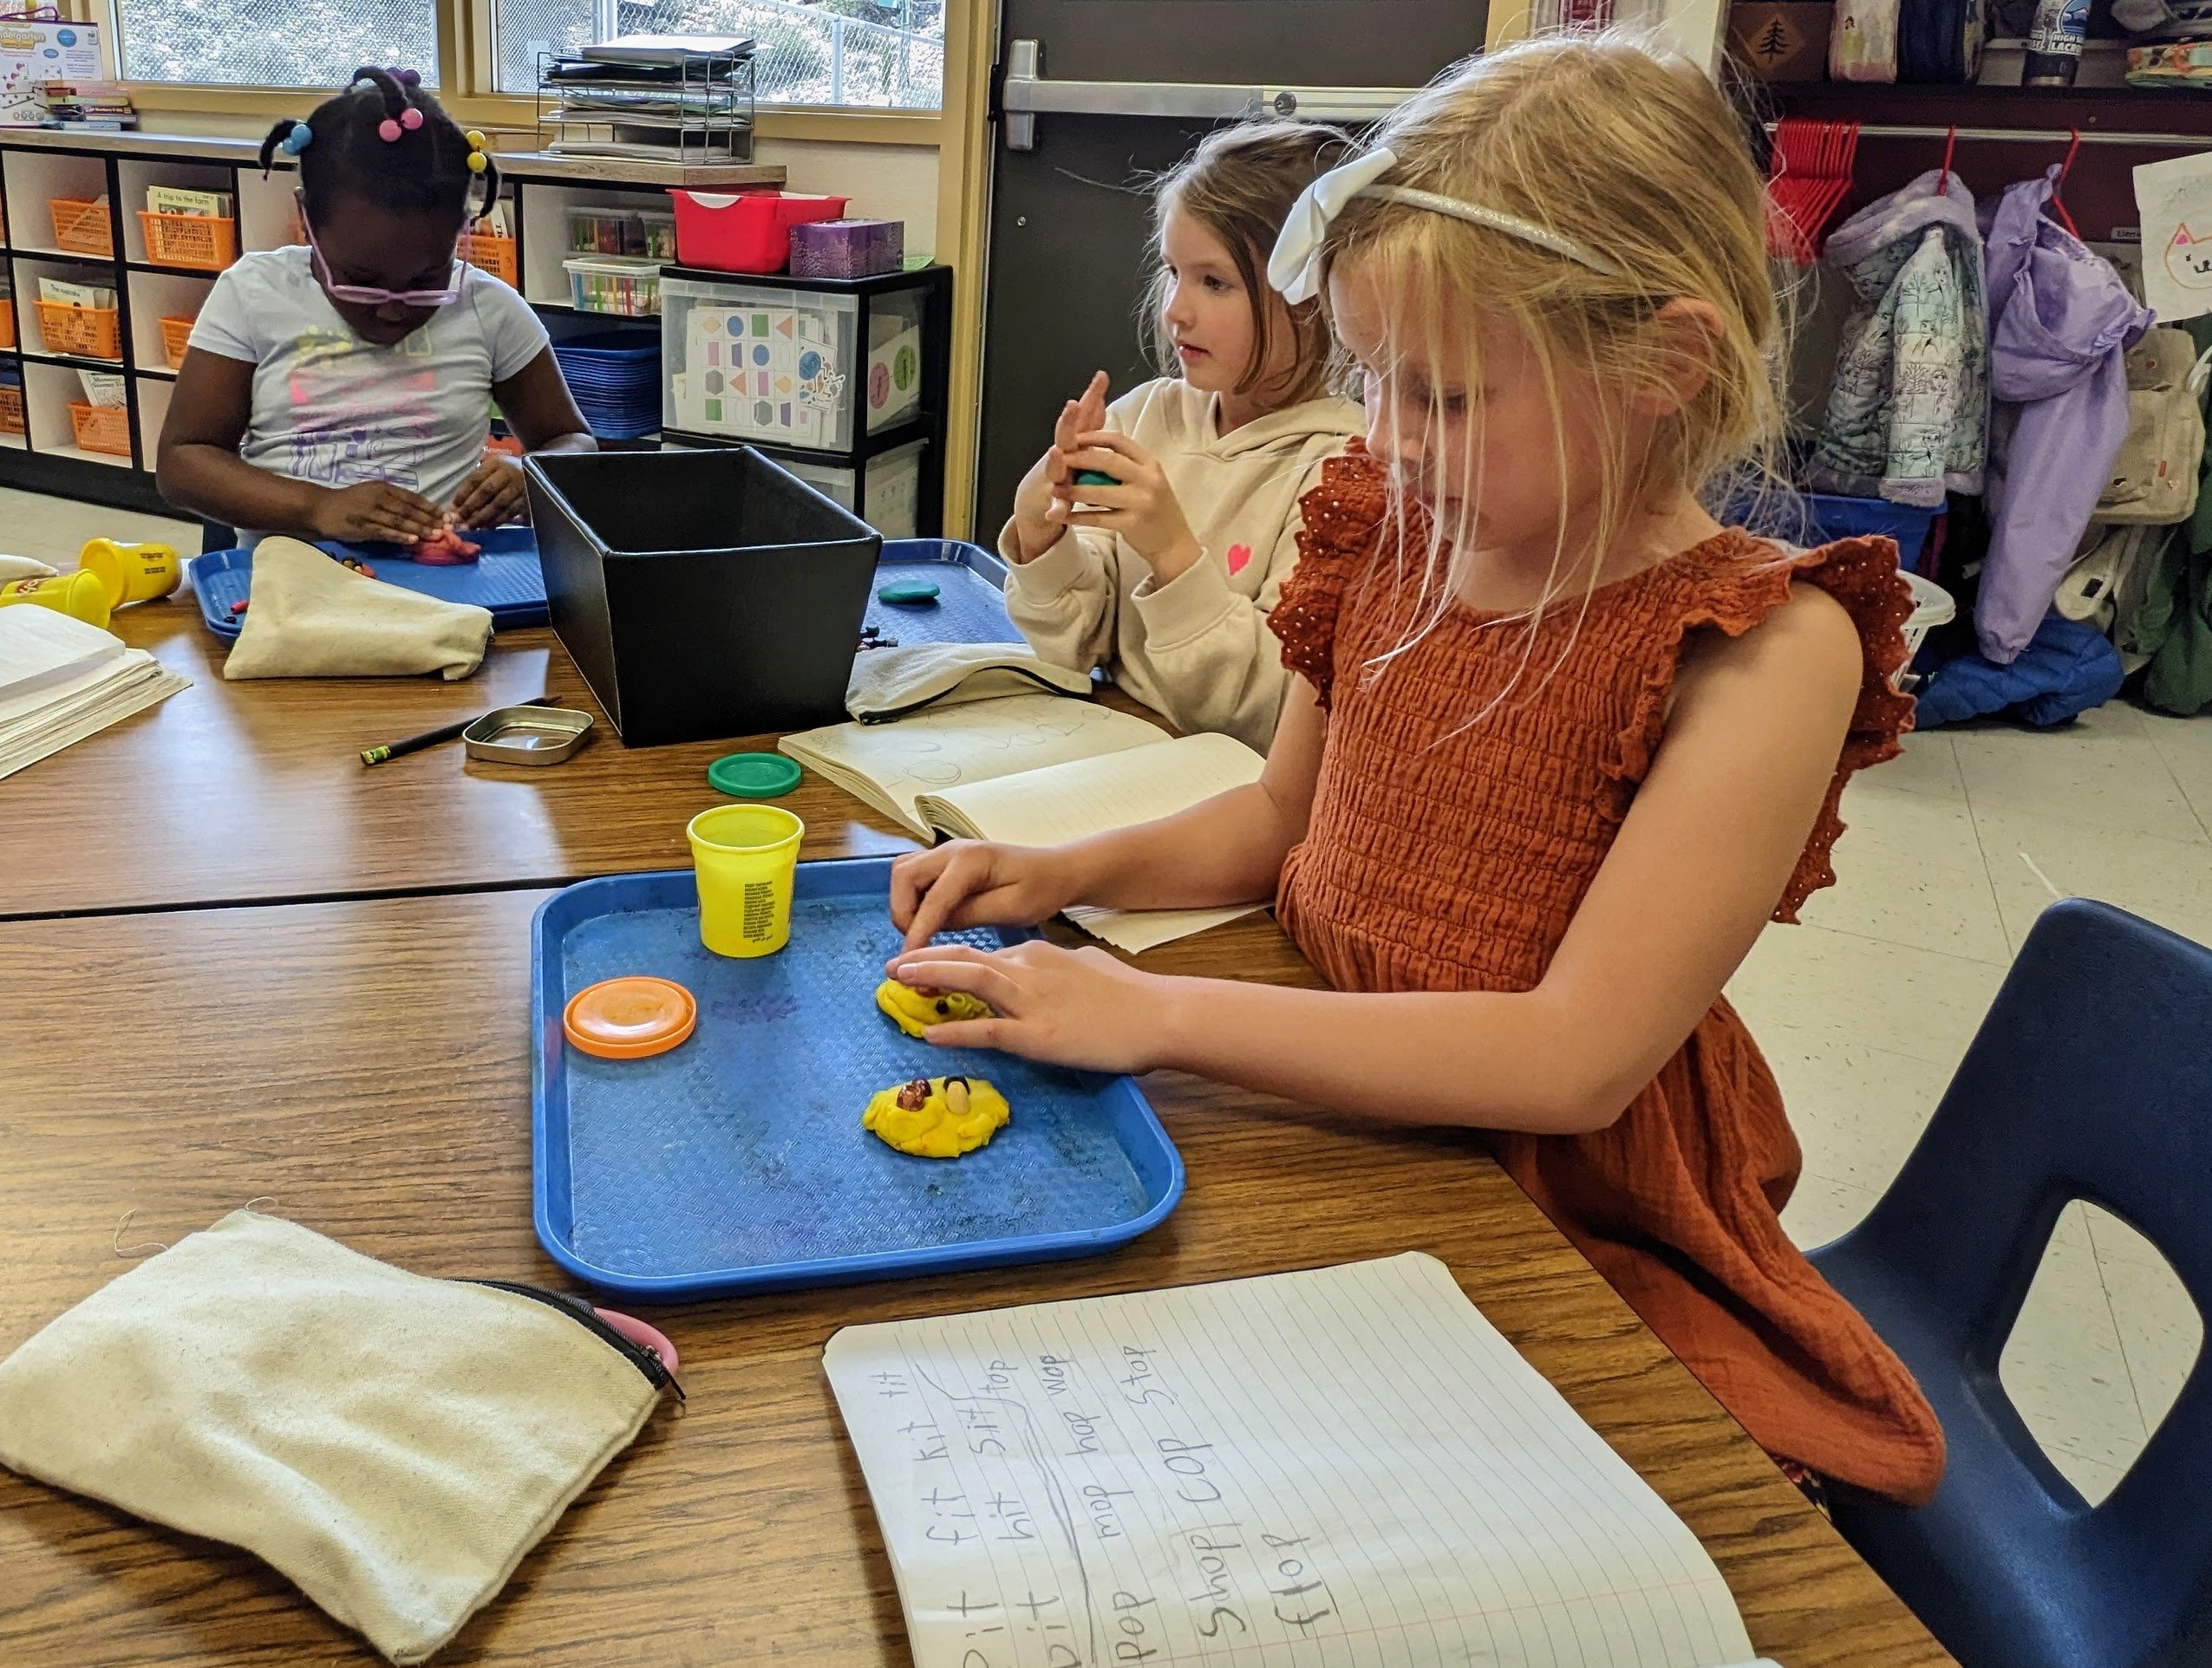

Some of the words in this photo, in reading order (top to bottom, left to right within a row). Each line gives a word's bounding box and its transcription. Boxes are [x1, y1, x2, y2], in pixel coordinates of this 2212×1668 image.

[921, 1487, 979, 1546] fit
[985, 1492, 1034, 1540] hit
[1112, 1591, 1158, 1660] pop
